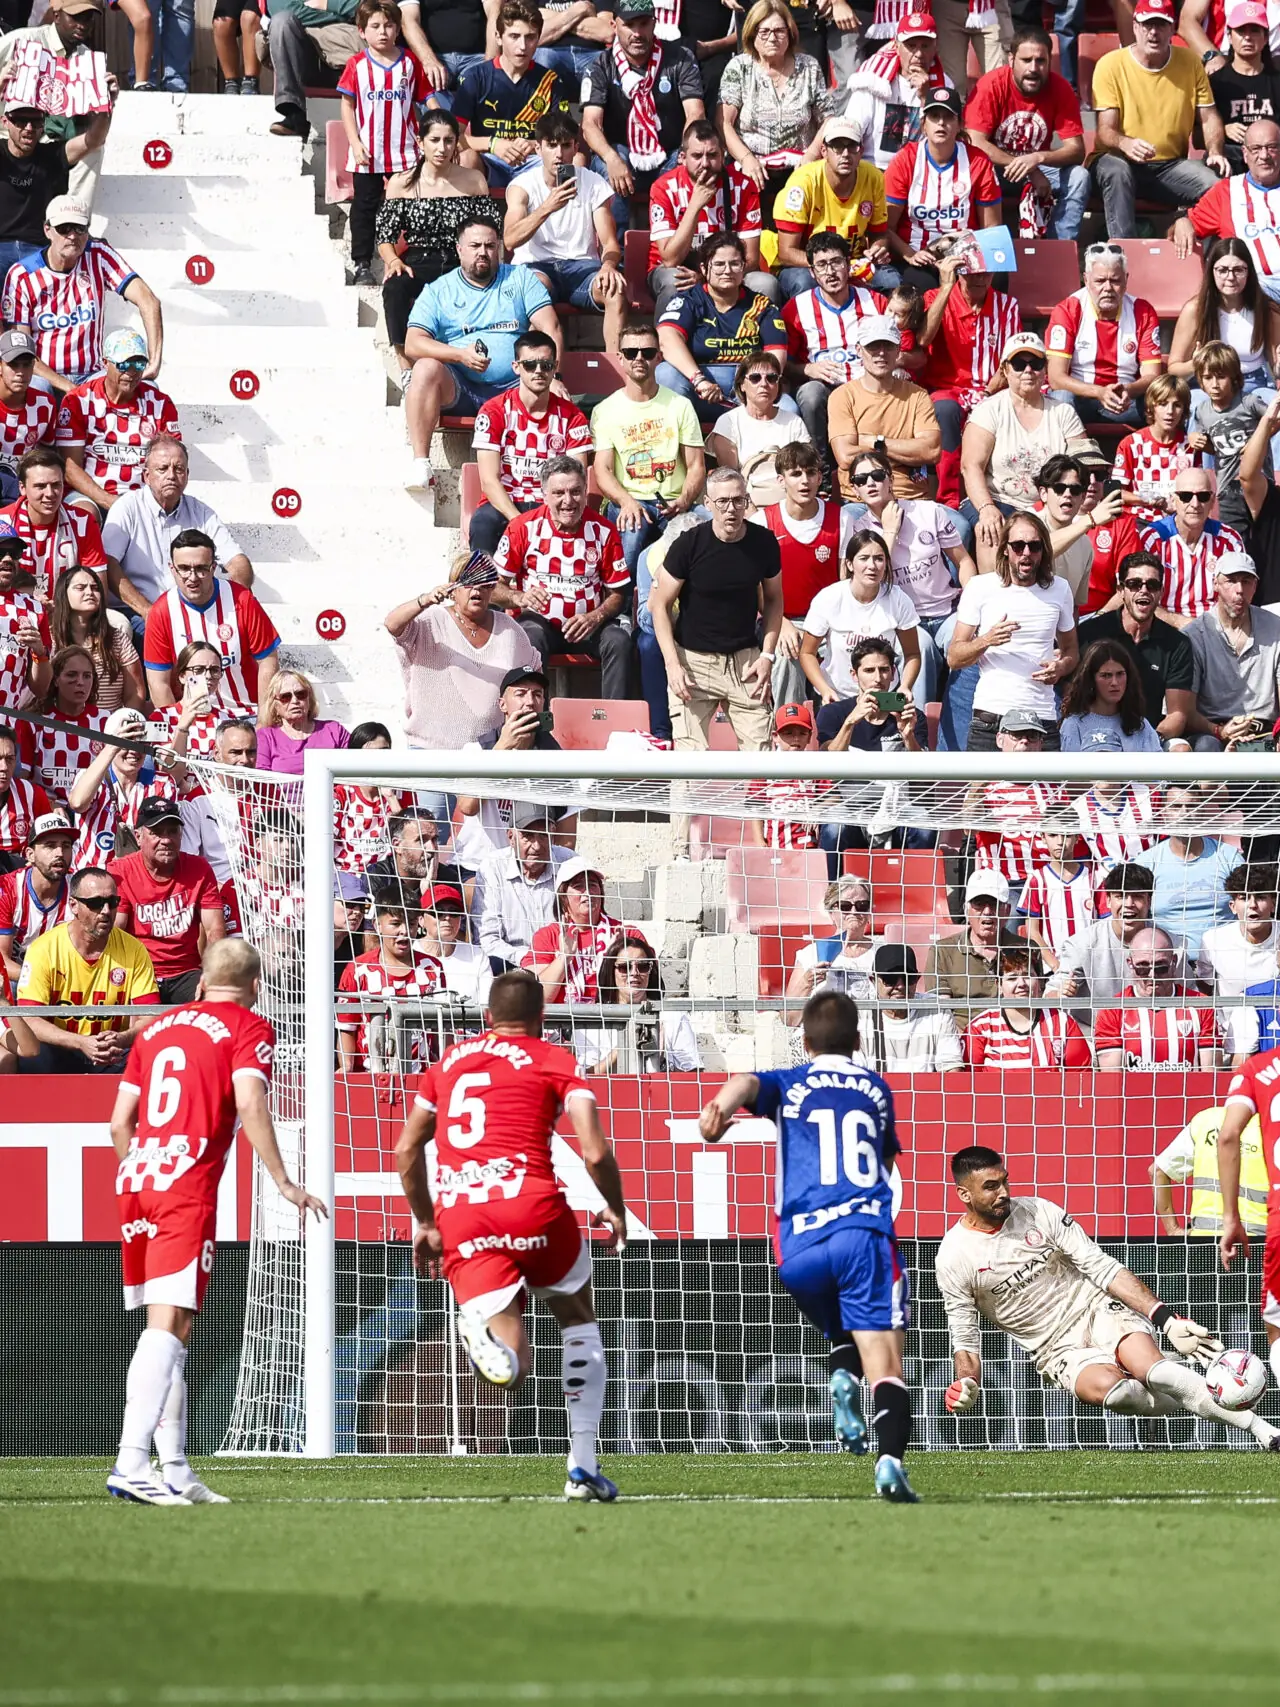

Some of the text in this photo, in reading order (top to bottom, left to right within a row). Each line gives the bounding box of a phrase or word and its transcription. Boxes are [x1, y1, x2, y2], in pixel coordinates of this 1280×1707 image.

[367, 90, 407, 101] GIRONA
[1230, 100, 1274, 116] FILA
[147, 147, 166, 161] 12
[914, 205, 965, 220] Gosbi
[192, 262, 206, 276] 11
[38, 302, 96, 331] Gosbi
[704, 337, 759, 348] ETIHAD
[234, 378, 253, 392] 10
[501, 455, 549, 467] ETIHA
[276, 495, 298, 510] 09
[892, 555, 938, 576] TIHAD
[536, 574, 590, 584] ETIHAD
[319, 616, 342, 632] 08
[152, 906, 195, 938] GIRON
[147, 1046, 186, 1127] 6
[447, 1072, 491, 1149] 5
[806, 1109, 879, 1188] 16
[474, 1234, 547, 1253] parlem
[200, 1240, 212, 1272] 6
